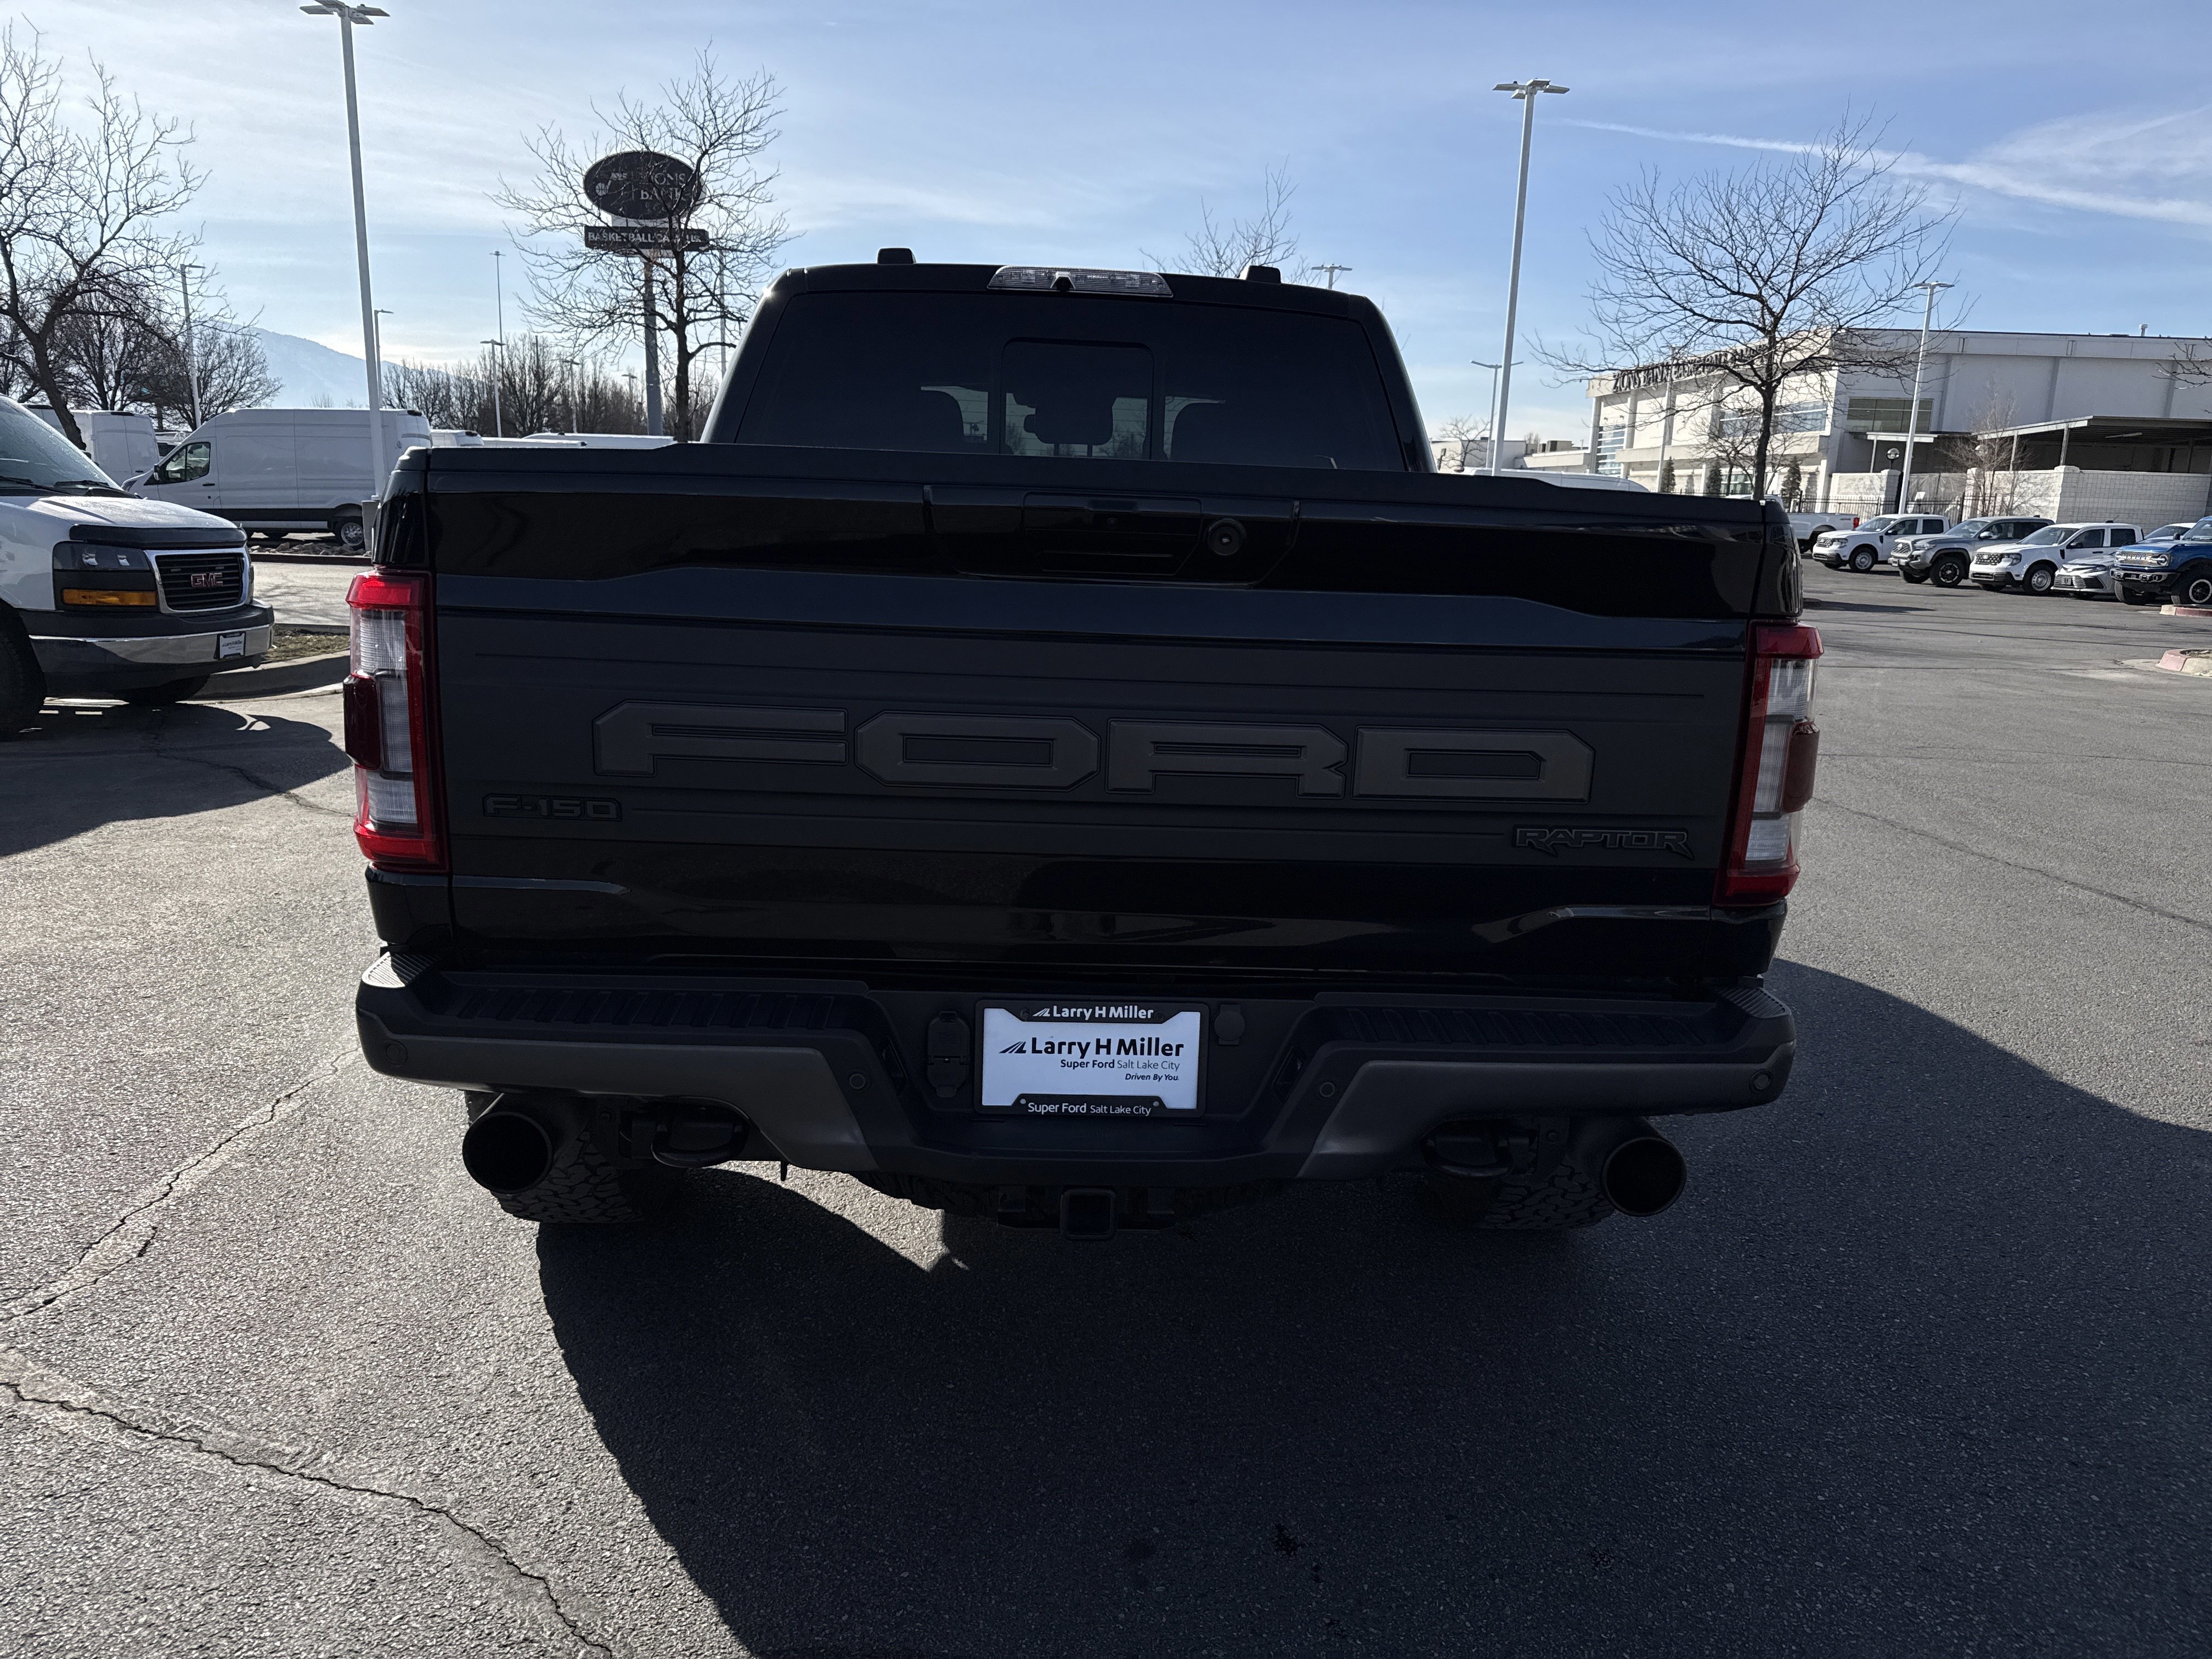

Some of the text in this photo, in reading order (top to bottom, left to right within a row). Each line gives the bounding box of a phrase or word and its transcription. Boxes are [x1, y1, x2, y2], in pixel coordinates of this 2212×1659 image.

[640, 173, 686, 185] ONS
[190, 572, 223, 588] GMC
[591, 700, 1595, 803] FORD
[483, 794, 621, 821] F-150
[1515, 827, 1694, 861] RAPTOR
[1053, 1005, 1154, 1020] Larry H Miller
[1031, 1037, 1184, 1059] Larry H Miller
[1060, 1059, 1180, 1071] Super Ford Salt Lake City
[1153, 1074, 1163, 1082] By
[1028, 1102, 1152, 1117] Super Ford Salt Lake City
